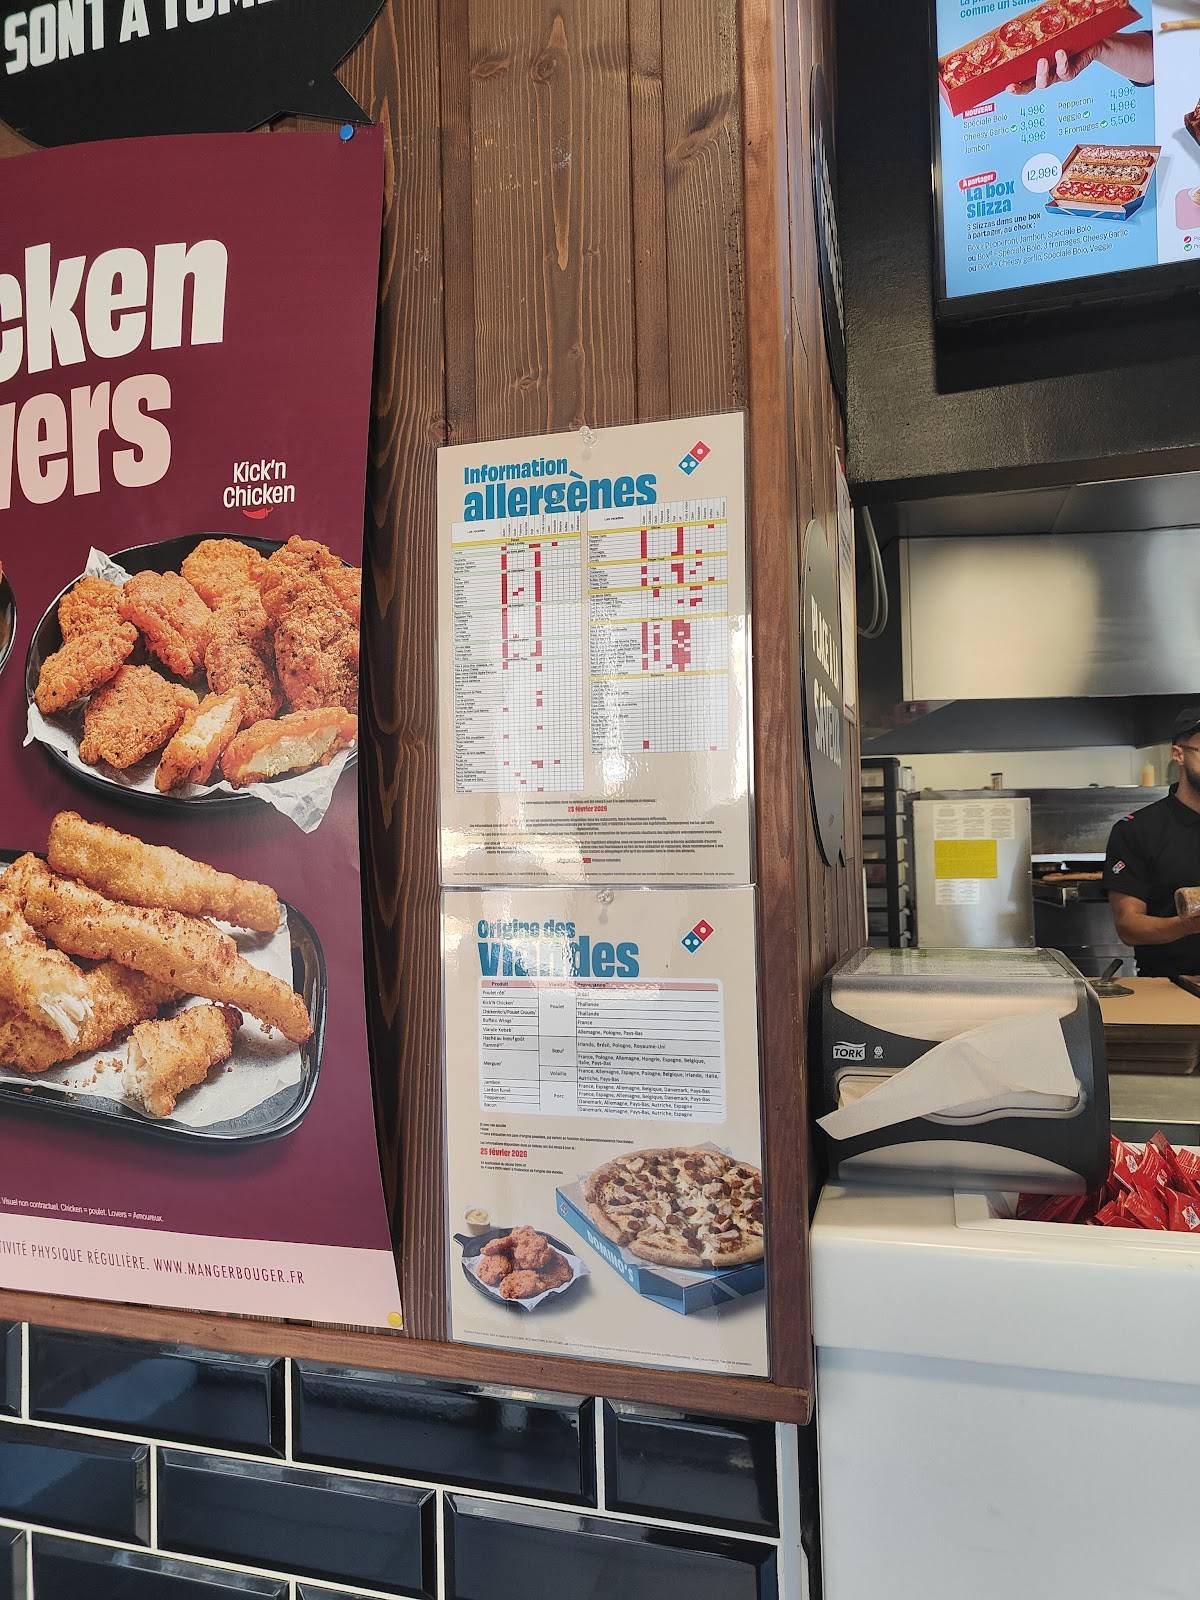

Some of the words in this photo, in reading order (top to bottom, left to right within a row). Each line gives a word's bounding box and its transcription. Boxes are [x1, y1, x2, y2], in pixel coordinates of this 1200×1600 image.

[960, 4, 995, 18] comme
[997, 0, 1010, 12] un
[4, 0, 104, 75] SONT
[1026, 166, 1058, 181] 12,99€
[966, 186, 982, 202] La
[986, 180, 1014, 198] box
[966, 199, 1012, 218] Slizza
[1028, 212, 1041, 220] box
[232, 459, 286, 483] Kick'n
[463, 457, 568, 485] Information
[222, 484, 296, 508] Chicken
[463, 470, 657, 522] allergènes
[544, 919, 576, 938] des
[834, 1048, 863, 1058] TORK
[489, 1147, 510, 1157] février
[1, 1197, 18, 1206] Visuel
[60, 1203, 83, 1214] Chicken
[88, 1207, 107, 1216] poulet.
[108, 1209, 127, 1218] Lovers
[32, 1244, 83, 1262] PHYSIQUE
[87, 1249, 150, 1270] RÉGULIÈRE.
[153, 1258, 304, 1284] WWW.MANGERBOUGER.FR
